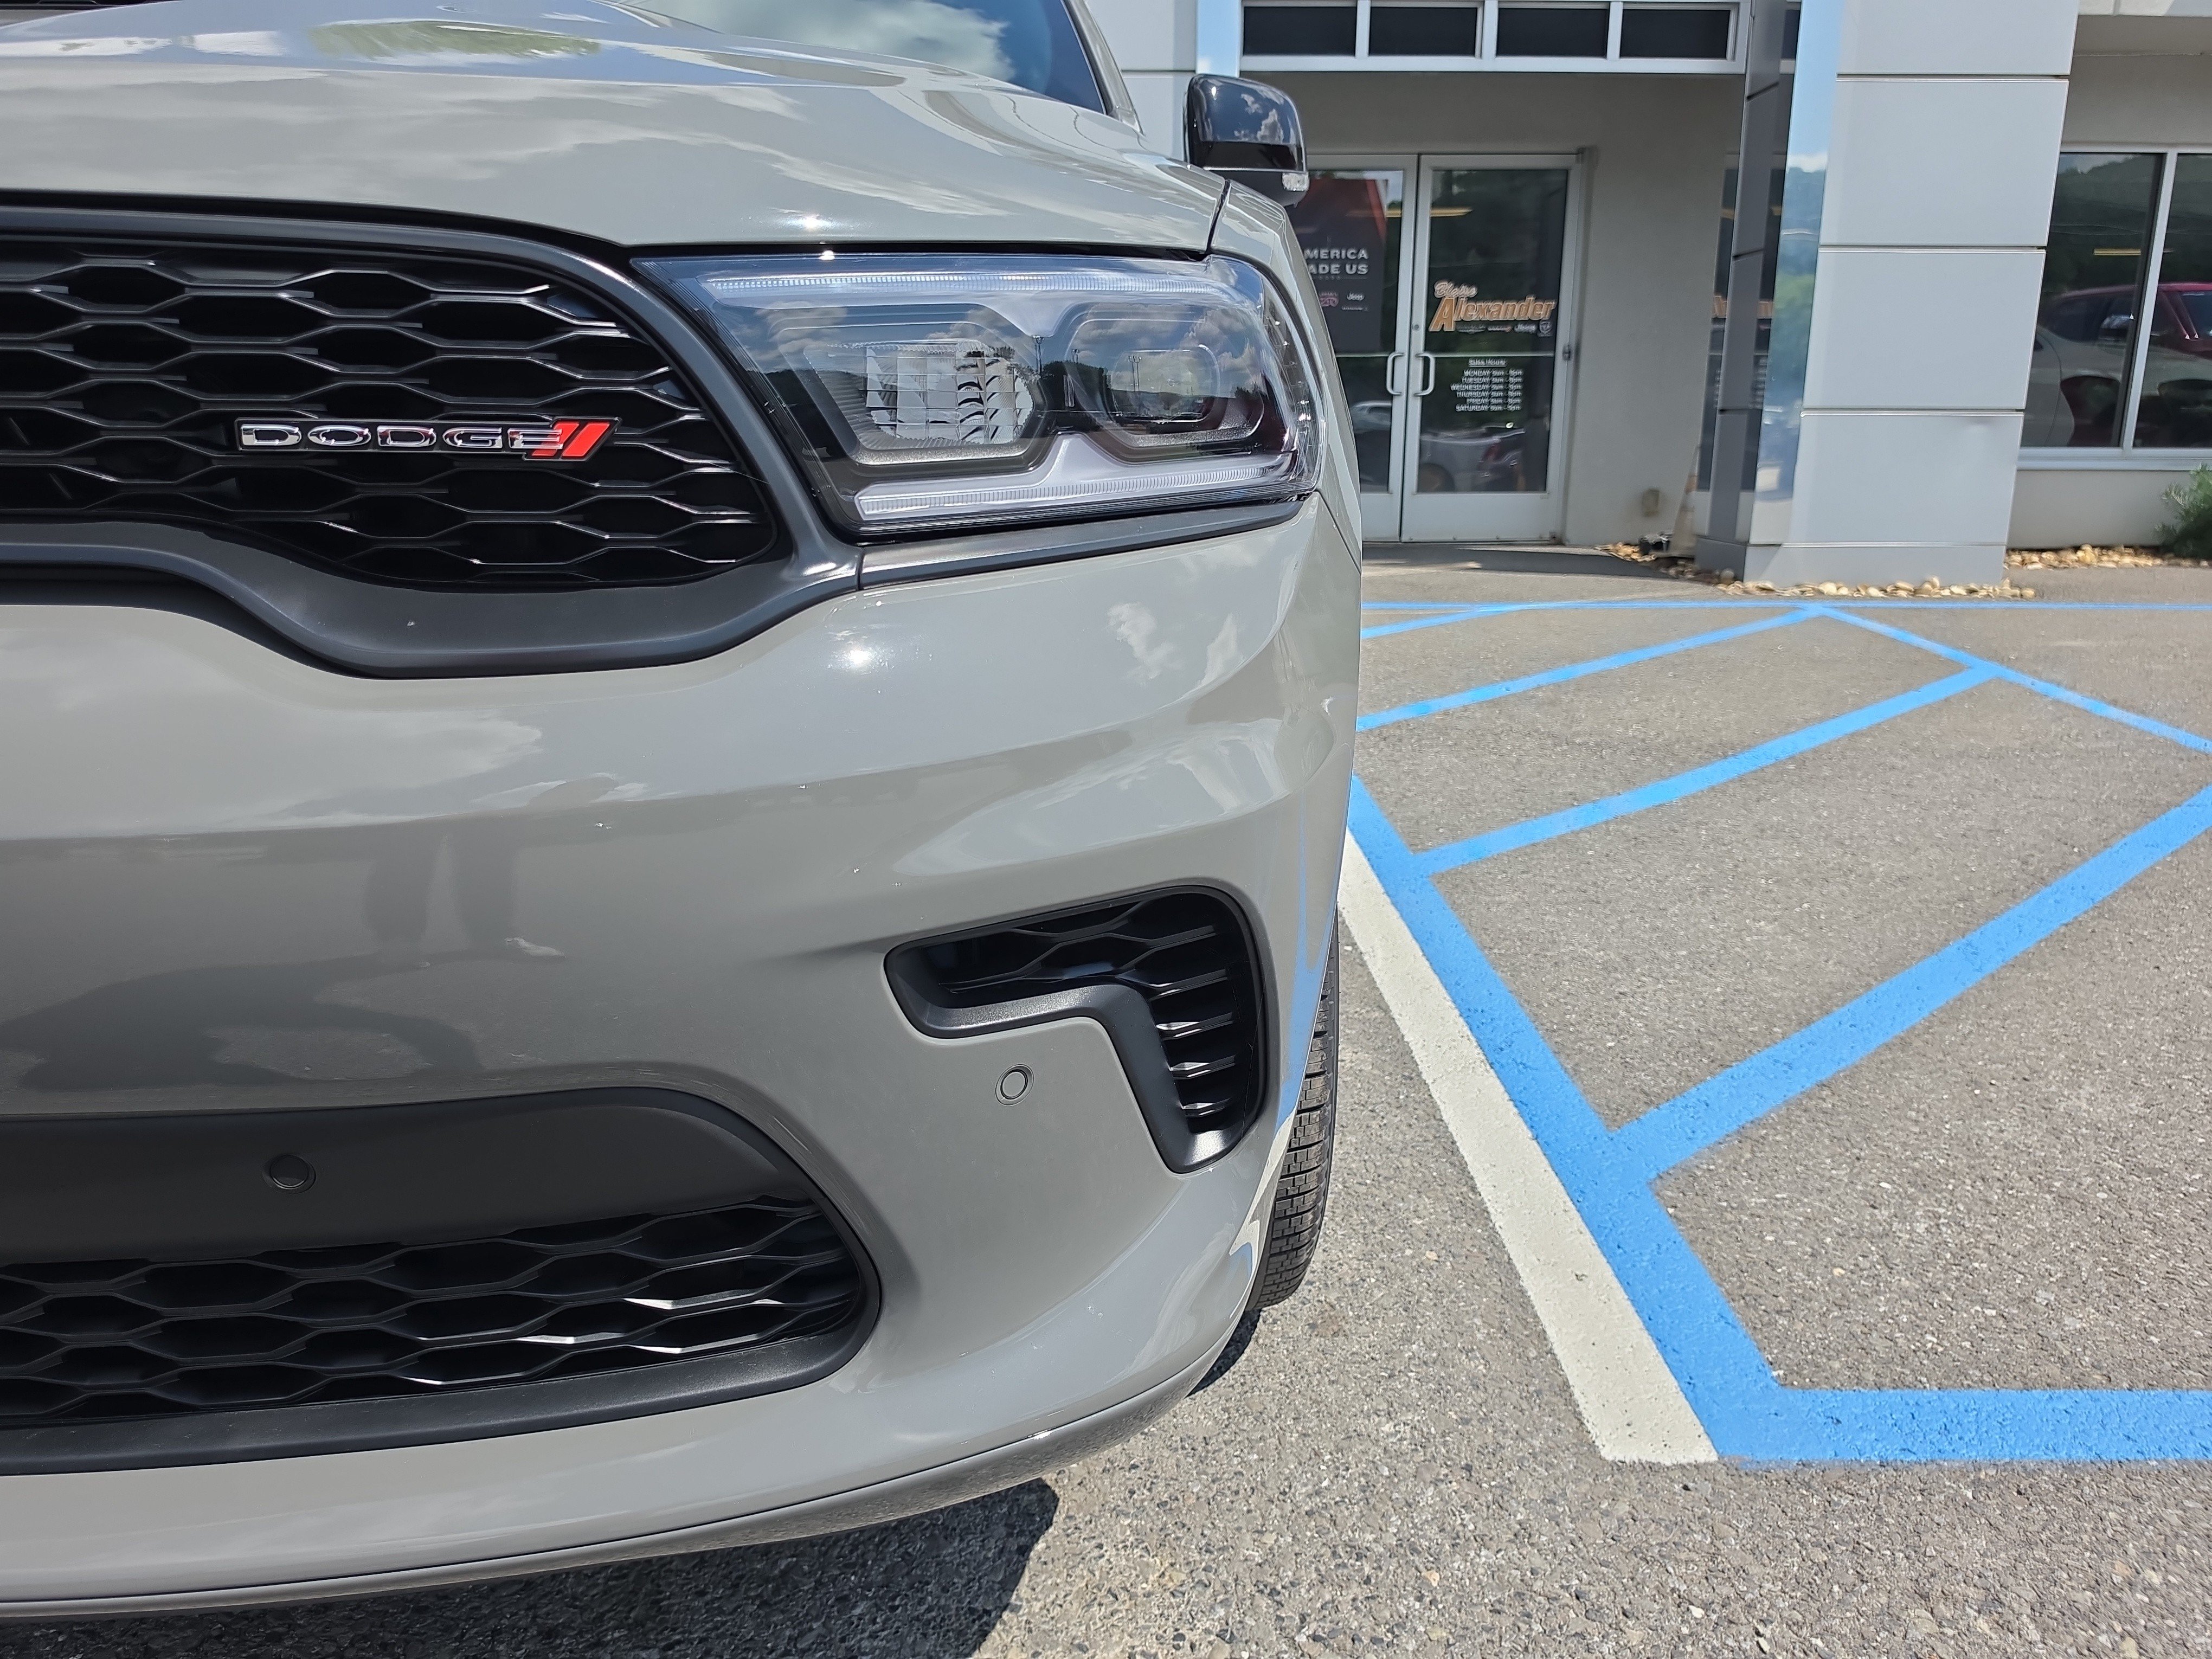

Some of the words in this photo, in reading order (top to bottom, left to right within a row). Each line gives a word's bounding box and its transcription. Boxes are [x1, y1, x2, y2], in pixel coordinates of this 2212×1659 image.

[1303, 248, 1368, 260] MERICA
[1307, 263, 1341, 274] ADE
[1345, 263, 1368, 274] US
[1429, 294, 1557, 332] Alexander
[240, 424, 563, 450] DODGE
